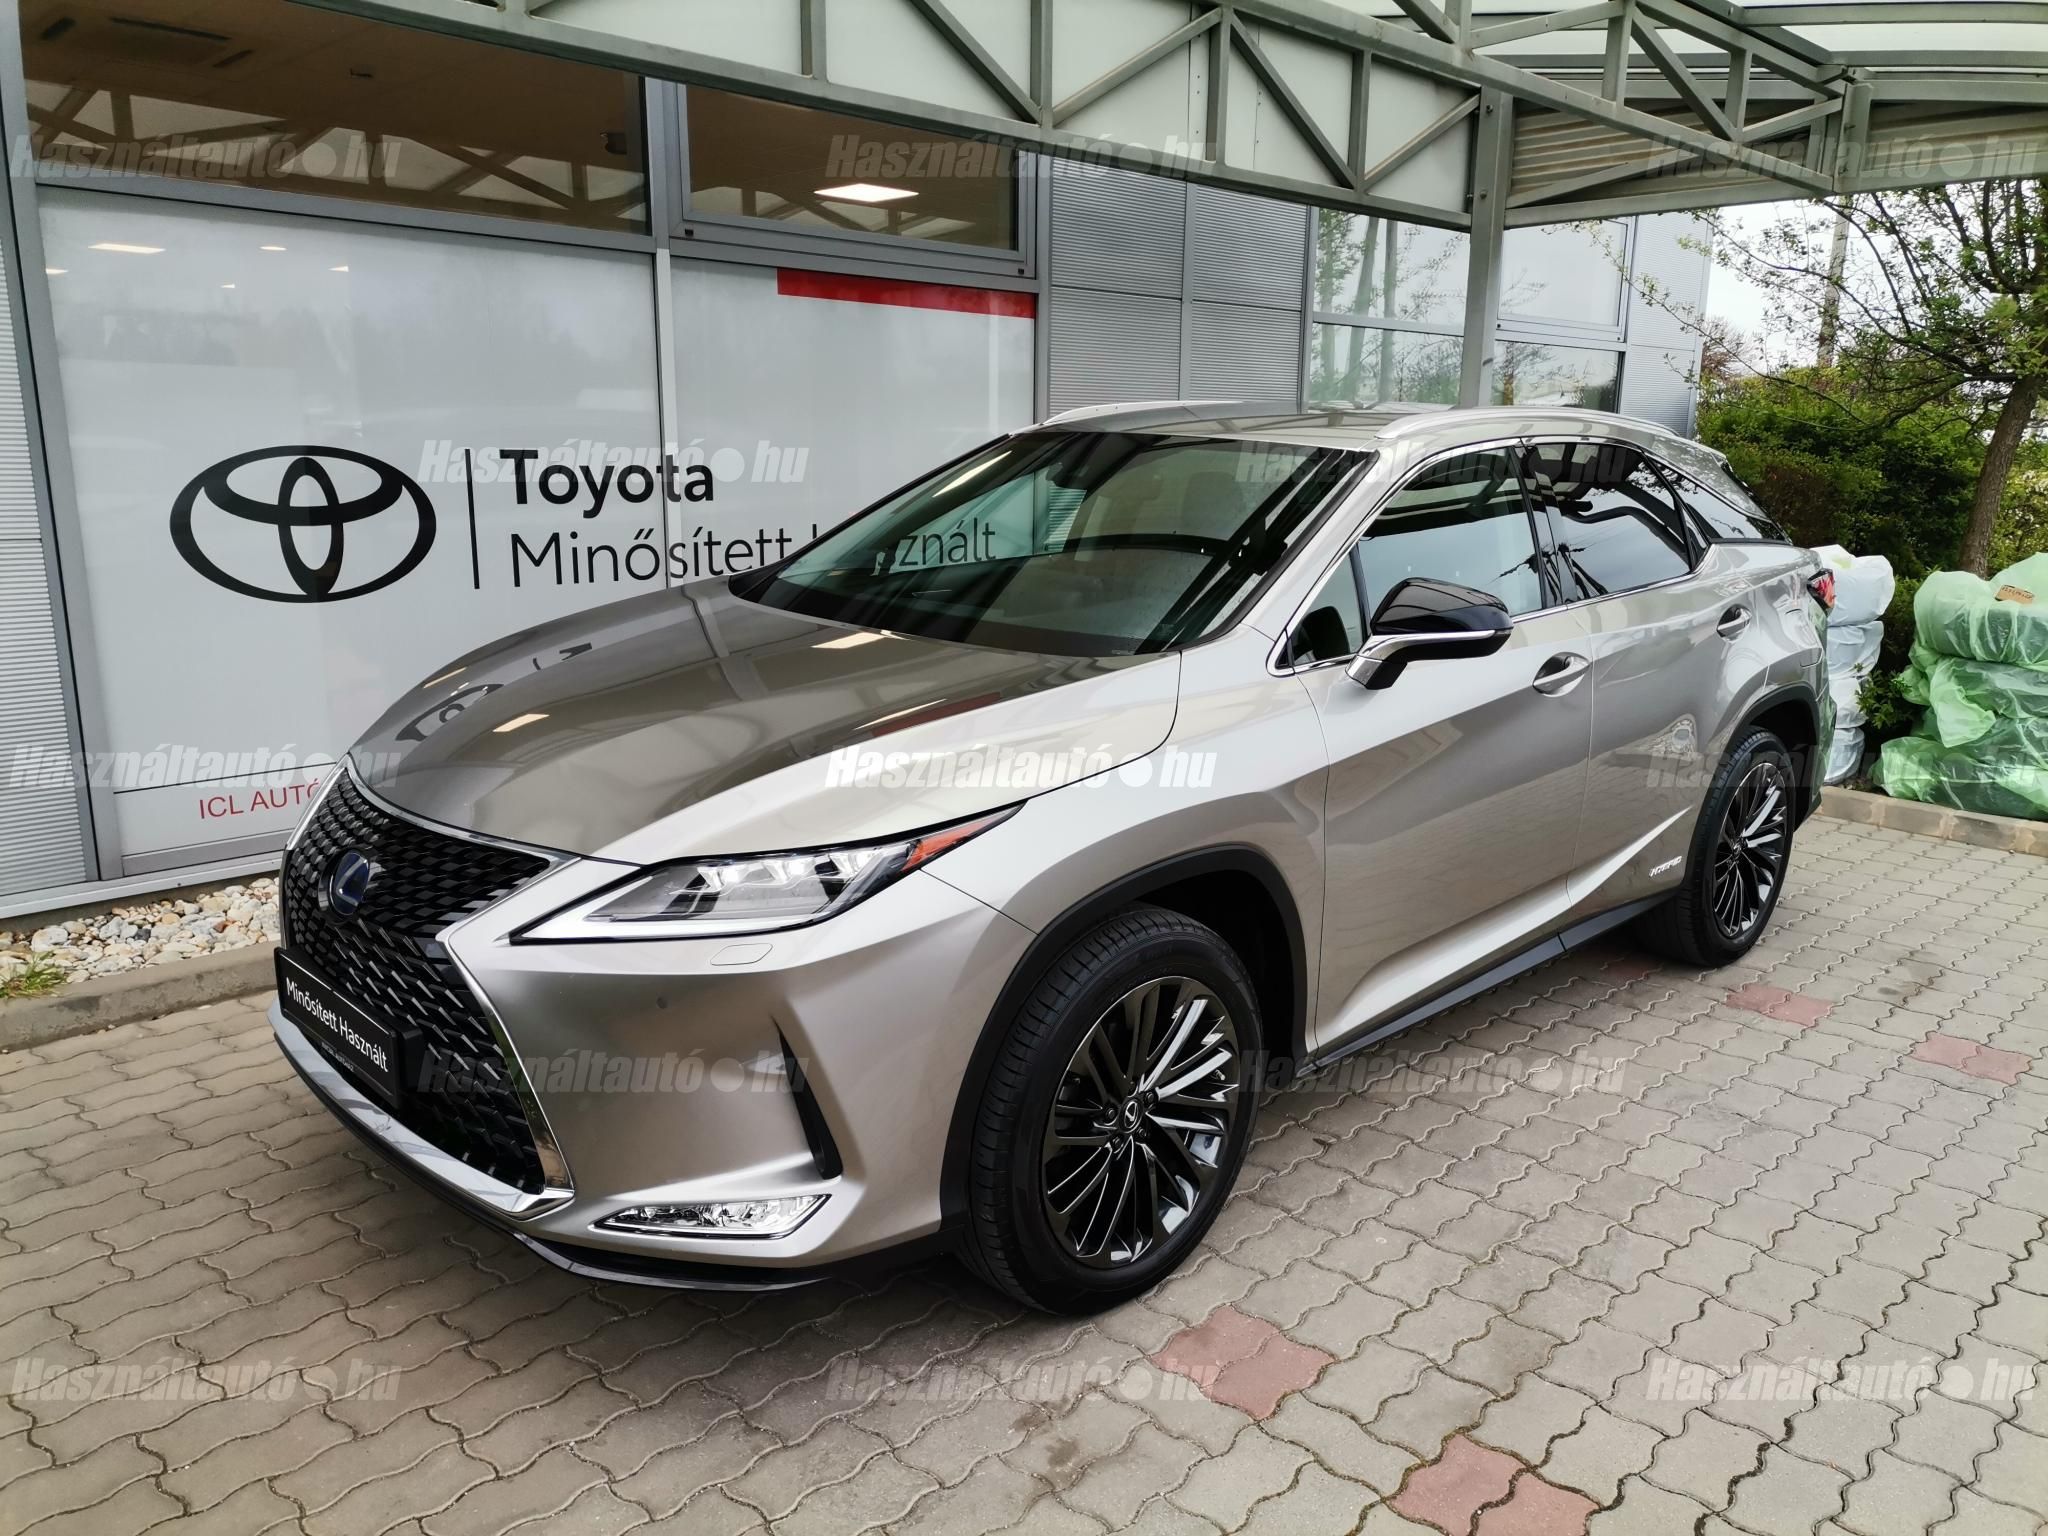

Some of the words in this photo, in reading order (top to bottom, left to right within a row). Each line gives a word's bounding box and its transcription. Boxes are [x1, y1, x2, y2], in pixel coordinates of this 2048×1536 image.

[499, 449, 714, 519] Toyota
[510, 526, 792, 588] Minősített
[199, 794, 244, 819] ICL
[286, 977, 339, 1033] Minősített
[340, 1016, 389, 1073] Használt
